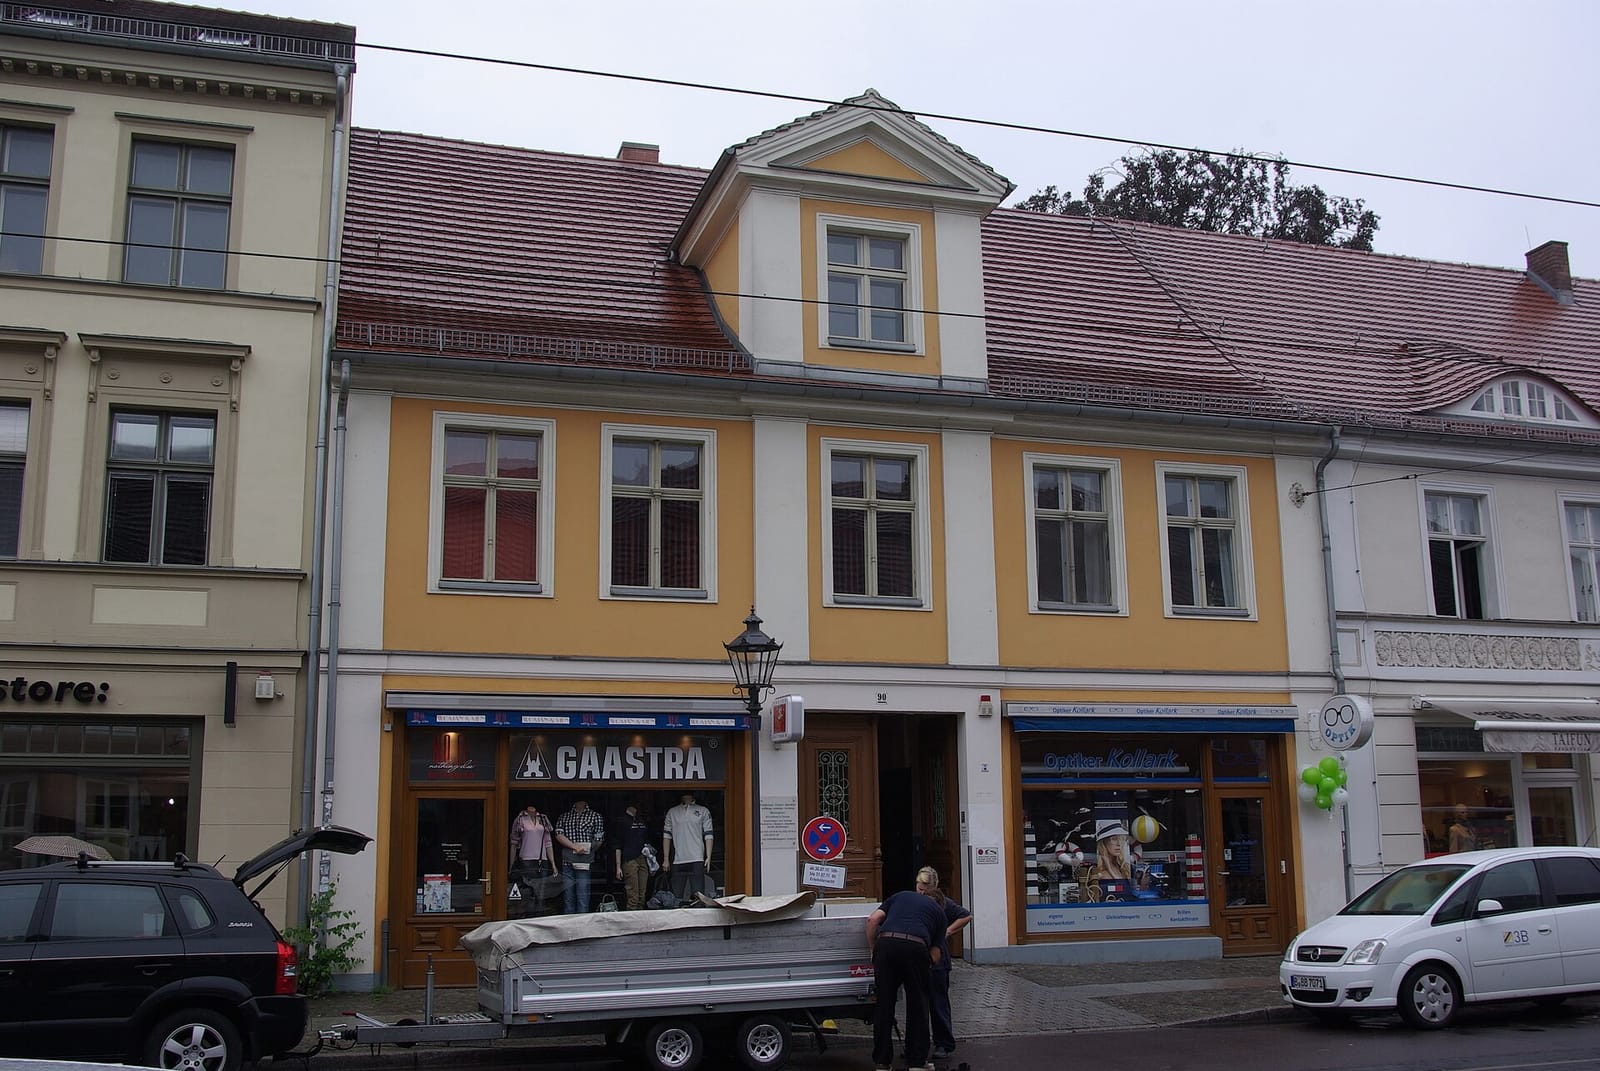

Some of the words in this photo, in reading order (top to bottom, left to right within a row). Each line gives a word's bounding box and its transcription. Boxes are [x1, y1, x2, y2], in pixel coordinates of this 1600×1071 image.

[877, 692, 887, 701] 90
[1325, 724, 1356, 743] OPTIK
[1552, 732, 1591, 746] TAIFUN
[556, 745, 707, 780] GAASTRA
[1043, 752, 1104, 770] Optiker
[1106, 747, 1179, 769] Kollark
[1513, 930, 1529, 943] 3B
